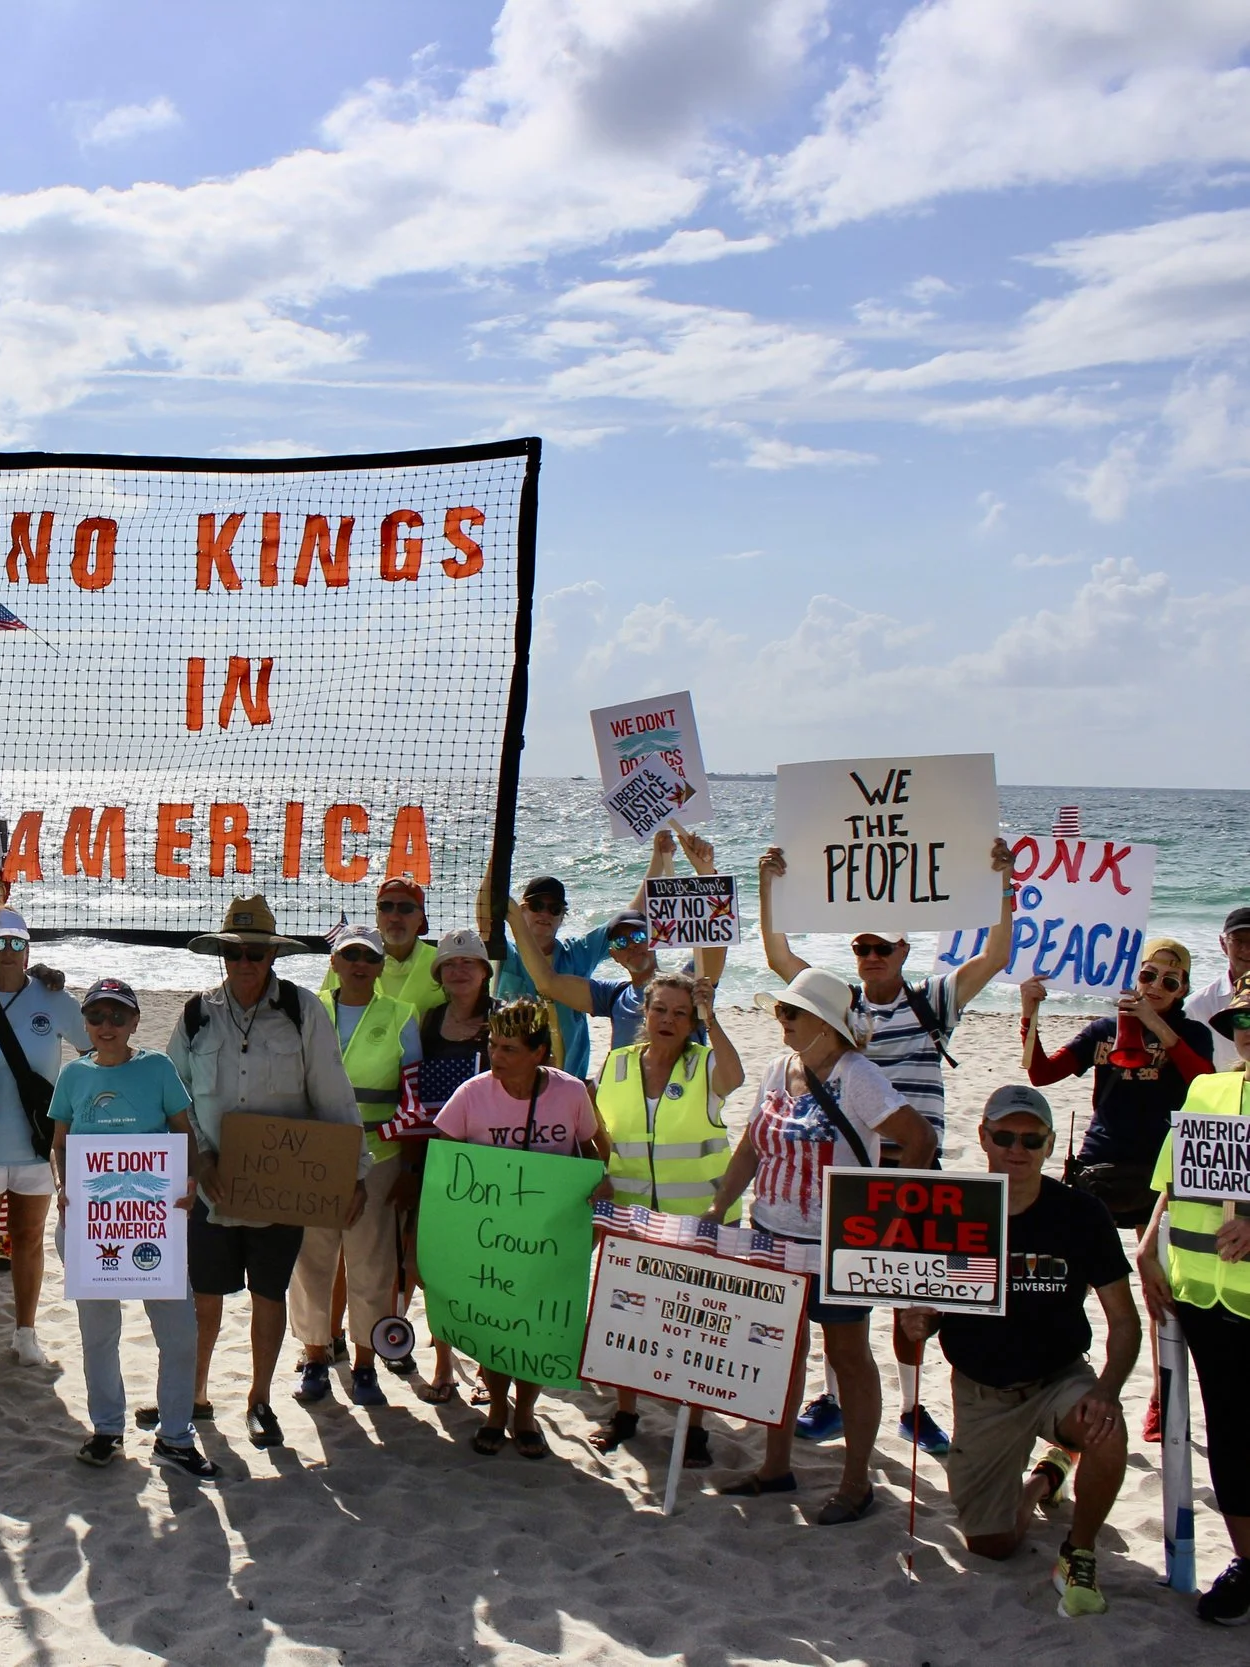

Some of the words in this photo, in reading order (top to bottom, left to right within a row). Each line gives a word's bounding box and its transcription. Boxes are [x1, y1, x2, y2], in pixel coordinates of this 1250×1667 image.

[6, 511, 117, 590] NO
[195, 505, 485, 591] KINGS
[186, 656, 273, 731] IN
[610, 718, 635, 738] WE
[636, 709, 676, 733] DON'T
[608, 774, 644, 812] LIBERTY
[642, 769, 657, 782] &
[620, 775, 673, 827] JUSTICE
[849, 769, 912, 806] WE
[632, 815, 658, 838] FOR
[654, 801, 673, 821] ALL
[844, 814, 909, 839] THE
[3, 801, 431, 887] AMERICA
[823, 842, 950, 903] PEOPLE
[1011, 836, 1132, 896] ONK
[654, 880, 673, 894] We
[688, 878, 726, 895] People
[648, 898, 677, 919] SAY
[681, 898, 705, 918] NO
[677, 919, 733, 943] KINGS
[261, 1123, 308, 1157] SAY
[488, 1123, 568, 1144] woke
[85, 1152, 114, 1172] WE
[117, 1151, 168, 1172] DON'T
[243, 1153, 280, 1175] NO
[298, 1160, 327, 1182] TO
[446, 1152, 546, 1206] Don't
[88, 1200, 112, 1222] DO
[116, 1200, 167, 1221] KINGS
[230, 1177, 340, 1217] FASCISM
[866, 1181, 963, 1216] FOR
[87, 1222, 102, 1239] IN
[104, 1222, 167, 1239] AMERICA
[477, 1217, 559, 1256] Crown
[842, 1215, 989, 1253] SALE
[102, 1258, 119, 1267] NO
[607, 1254, 632, 1268] THE
[636, 1255, 786, 1305] CONSTITUTION
[861, 1256, 910, 1276] The
[468, 1263, 517, 1297] the
[847, 1271, 984, 1301] Presidency
[1012, 1282, 1068, 1292] DIVERSITY
[676, 1290, 690, 1302] IS
[701, 1297, 728, 1313] OUR
[662, 1323, 692, 1339] NOT
[699, 1332, 728, 1348] THE
[442, 1325, 477, 1357] NO
[490, 1345, 573, 1381] KINGS
[605, 1331, 659, 1356] CHAOS
[682, 1349, 761, 1384] CRUELTY
[653, 1370, 673, 1382] OF
[688, 1379, 738, 1401] TRUMP
